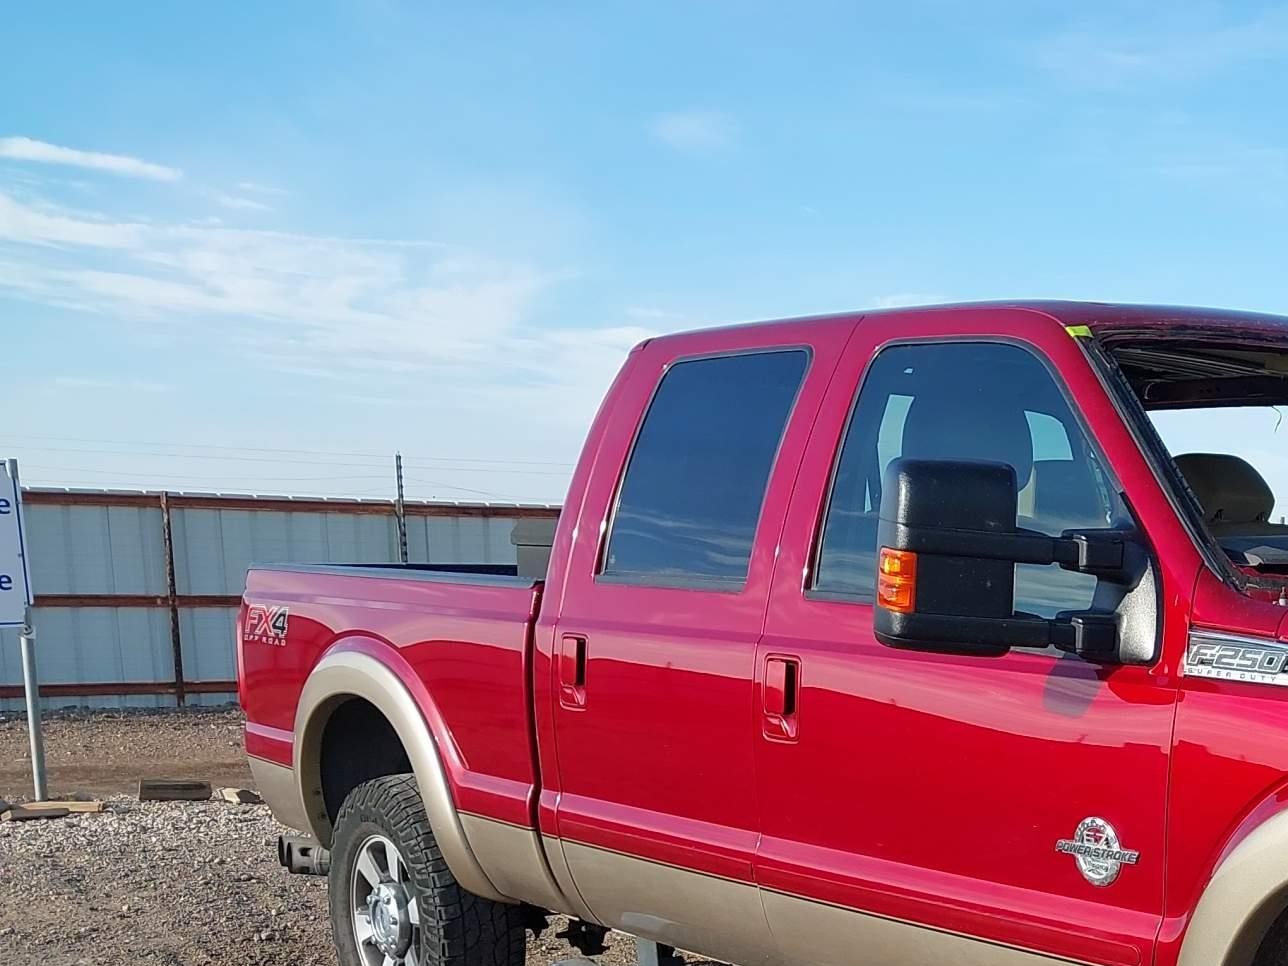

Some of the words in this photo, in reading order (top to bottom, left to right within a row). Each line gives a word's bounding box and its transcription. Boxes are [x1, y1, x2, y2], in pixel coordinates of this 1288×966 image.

[245, 604, 289, 638] FX4
[261, 636, 286, 646] ROAD
[1187, 643, 1288, 675] F-250
[1187, 667, 1232, 678] SUPER
[1239, 673, 1277, 682] DUTY
[1056, 841, 1091, 857] POWER
[1093, 847, 1137, 862] STROKE
